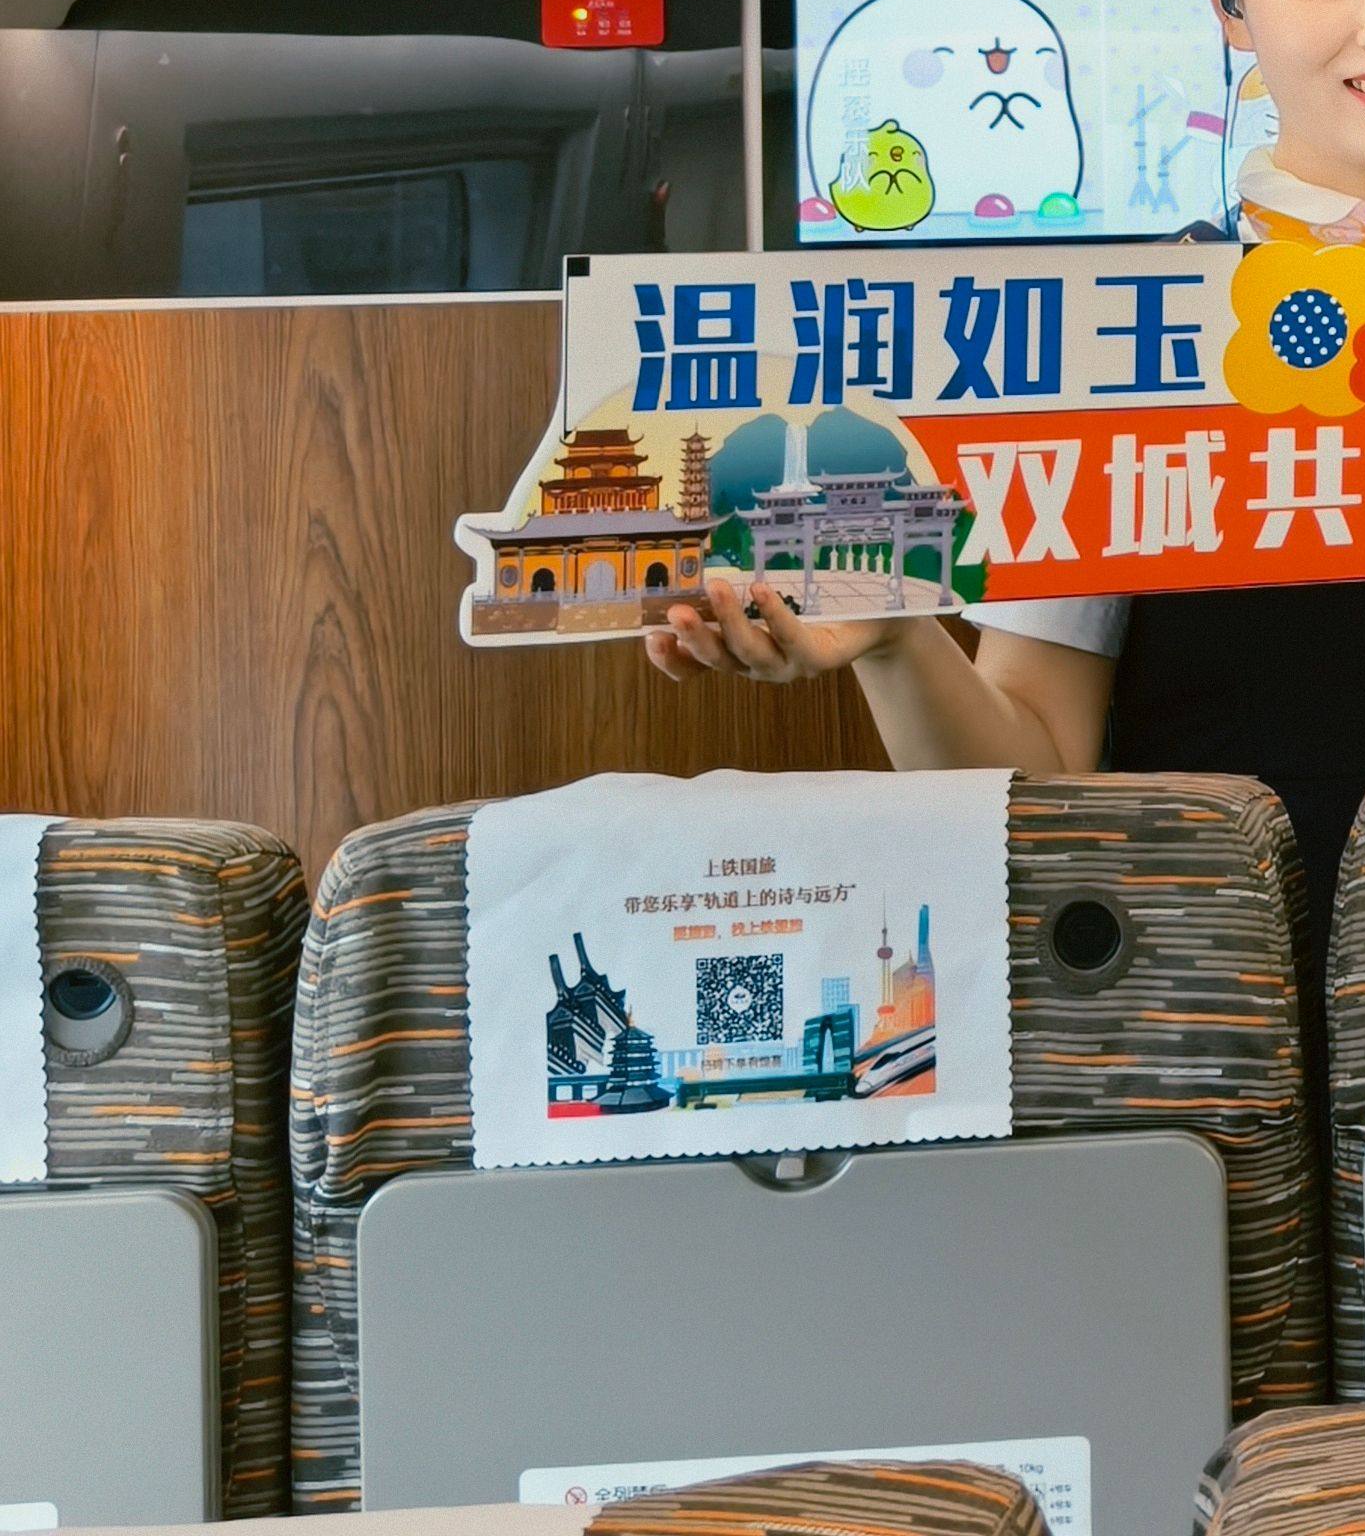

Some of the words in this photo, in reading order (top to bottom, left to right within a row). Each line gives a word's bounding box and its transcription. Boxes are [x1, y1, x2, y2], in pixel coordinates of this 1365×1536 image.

[632, 273, 1207, 413] 温润如玉
[704, 855, 777, 878] 上铁国旅
